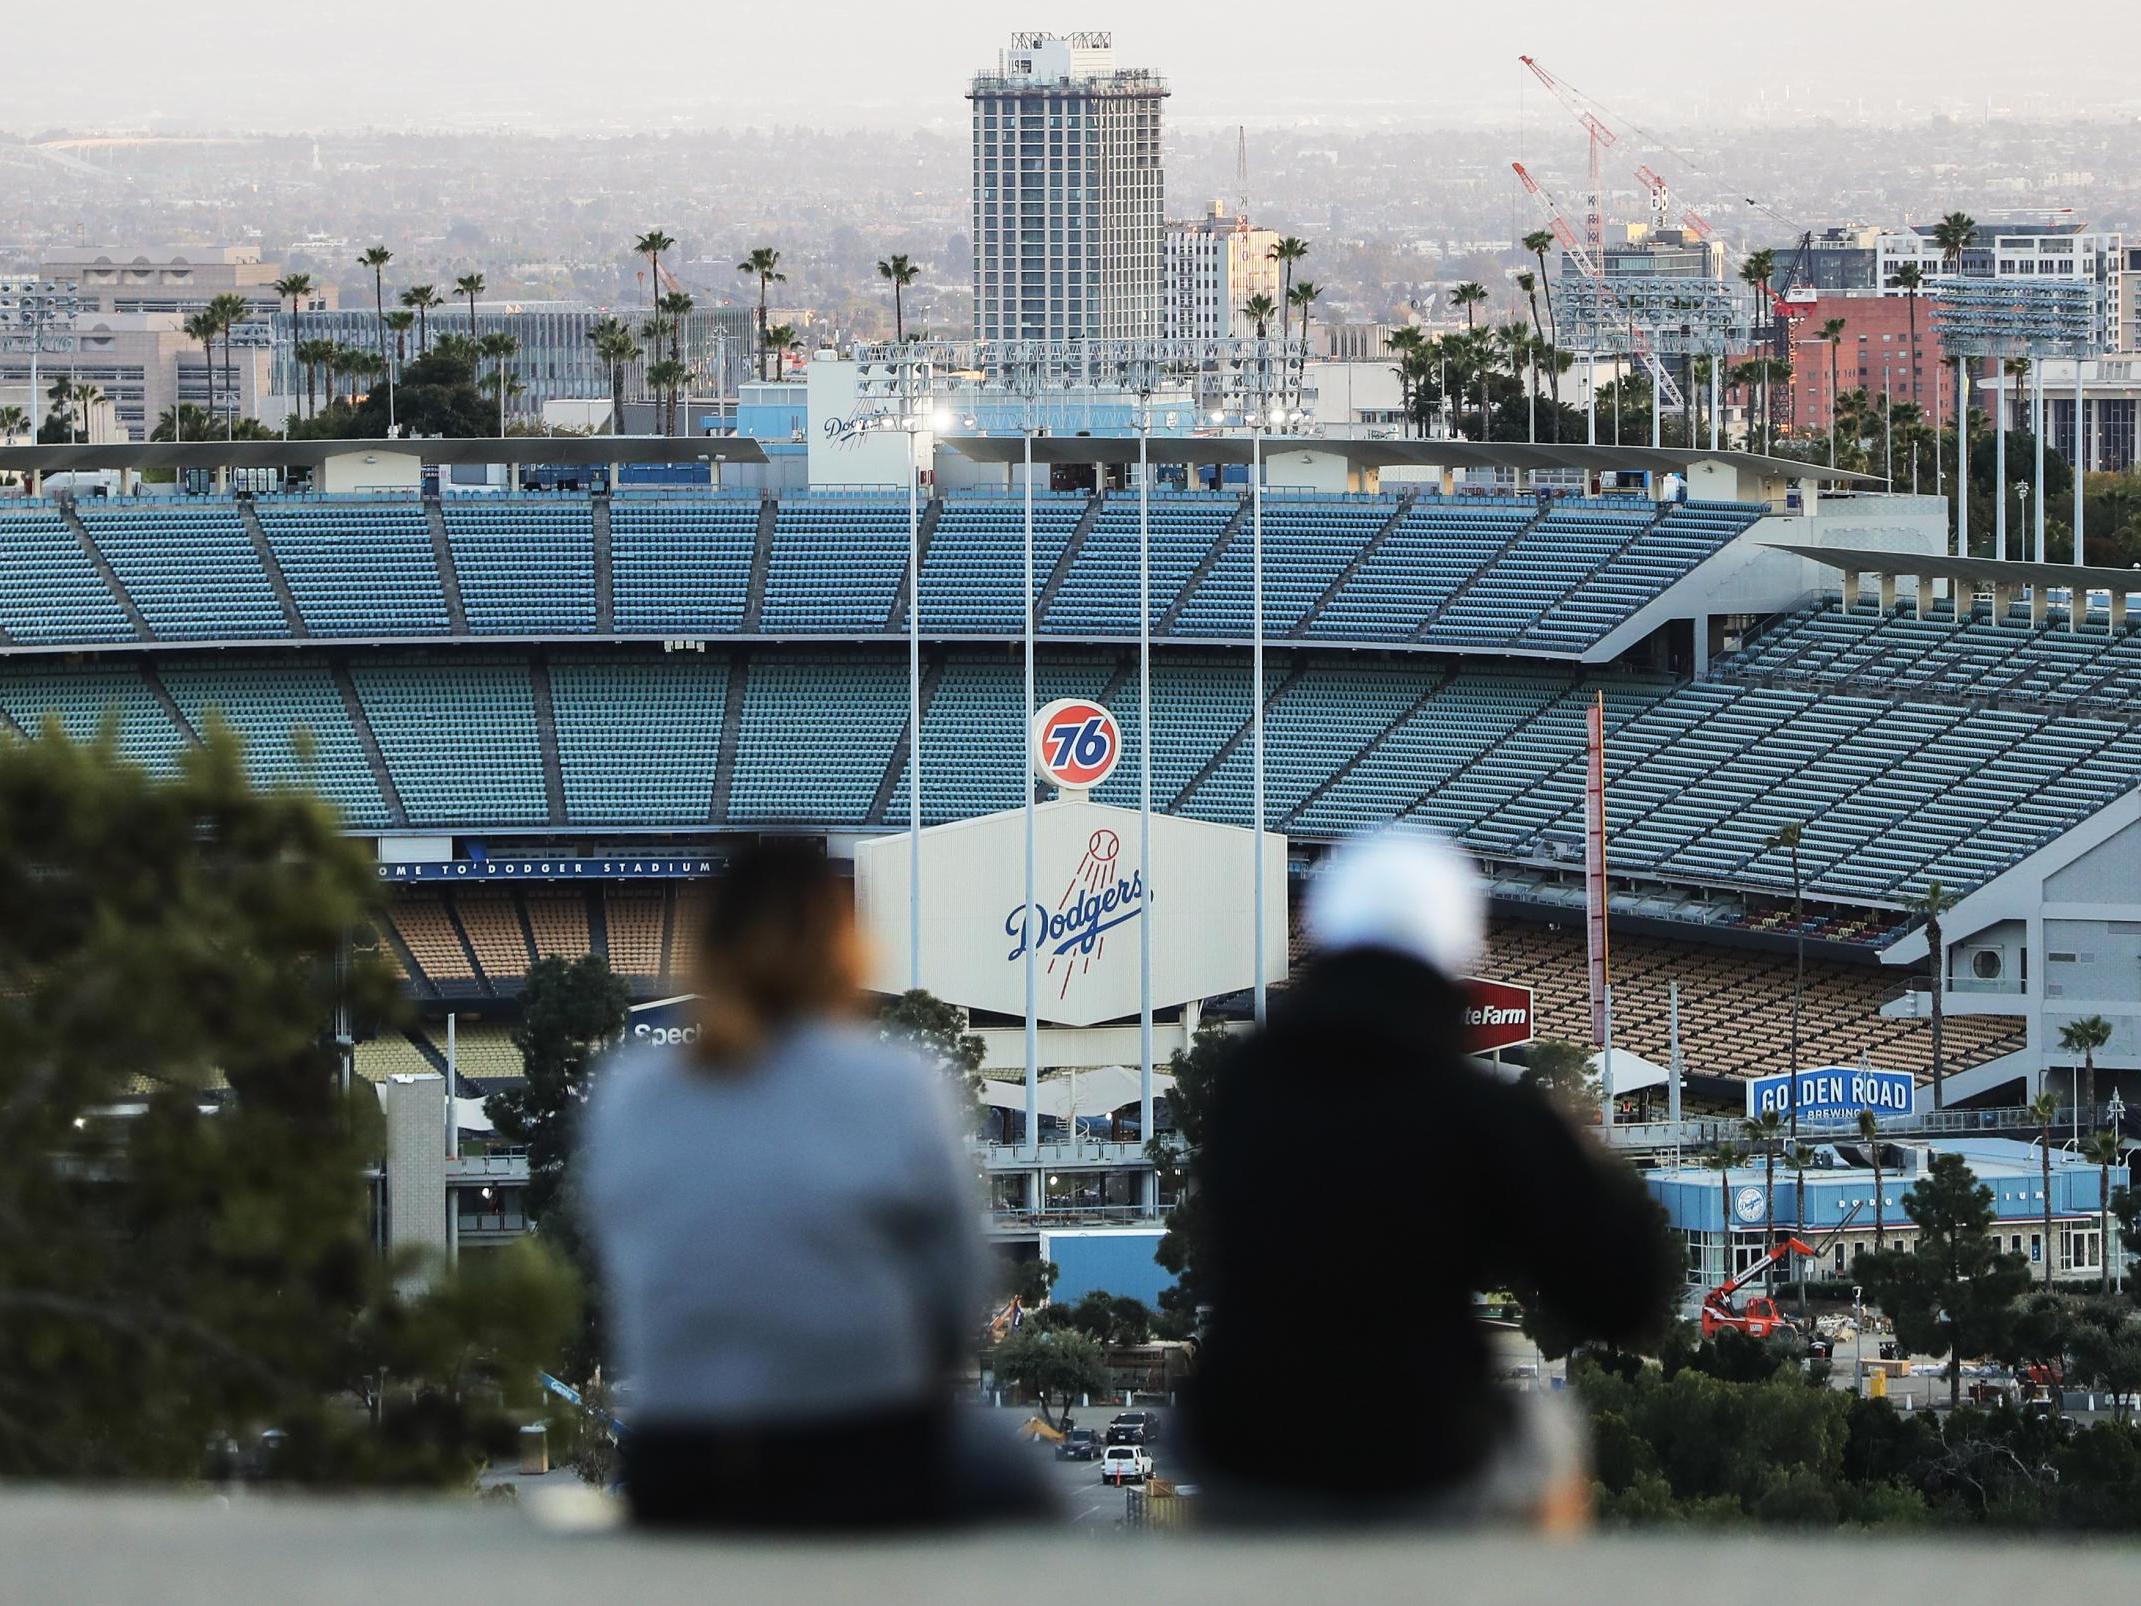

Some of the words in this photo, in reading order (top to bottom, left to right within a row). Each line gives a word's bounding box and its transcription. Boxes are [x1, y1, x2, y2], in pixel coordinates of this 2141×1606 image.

[1047, 716, 1110, 770] 76
[442, 864, 467, 875] TO
[488, 863, 582, 874] DODGER
[604, 862, 710, 873] STADIUM
[1005, 869, 1153, 962] Dodgers
[1762, 1077, 1843, 1112] GODEN
[1852, 1077, 1907, 1109] ROAD
